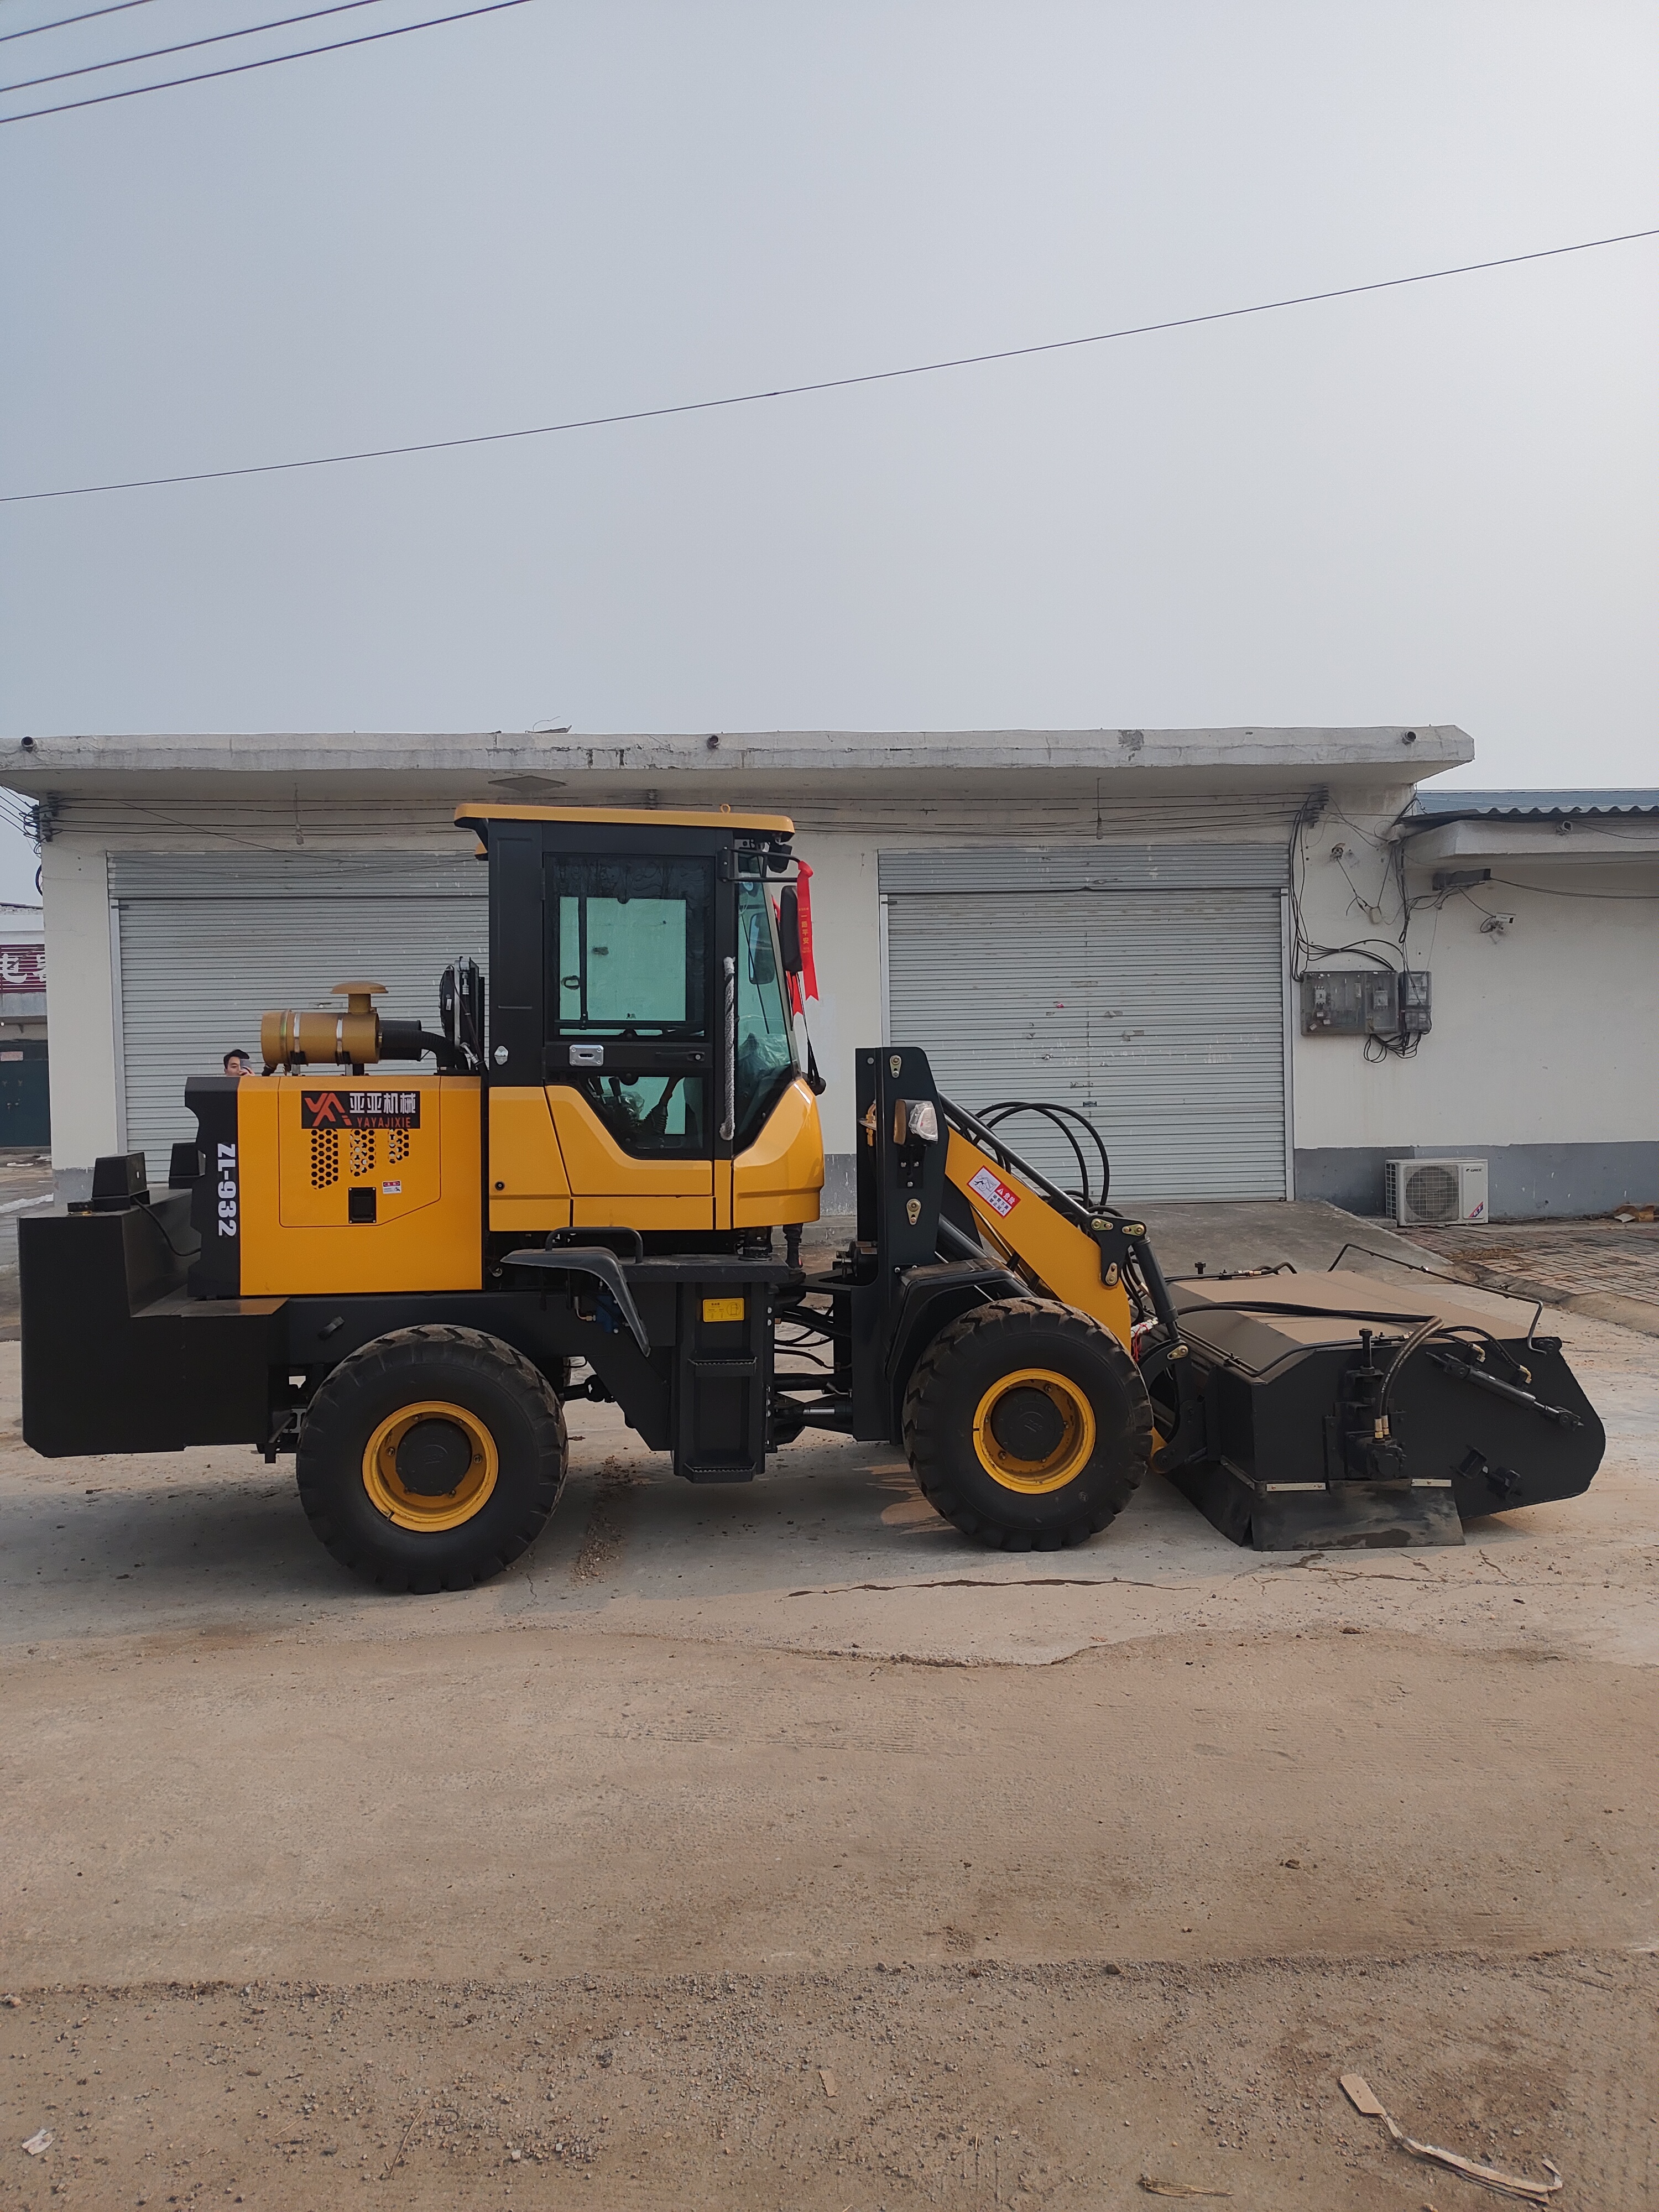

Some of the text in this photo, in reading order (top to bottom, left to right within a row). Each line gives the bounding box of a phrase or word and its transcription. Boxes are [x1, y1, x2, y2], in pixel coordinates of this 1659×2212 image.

[349, 1093, 416, 1114] 亚亚机械
[357, 1117, 411, 1128] YAYAJIXIE
[218, 1143, 237, 1237] ZL-932
[989, 1198, 1005, 1213] 禁止站人
[1003, 1192, 1015, 1205] 危险
